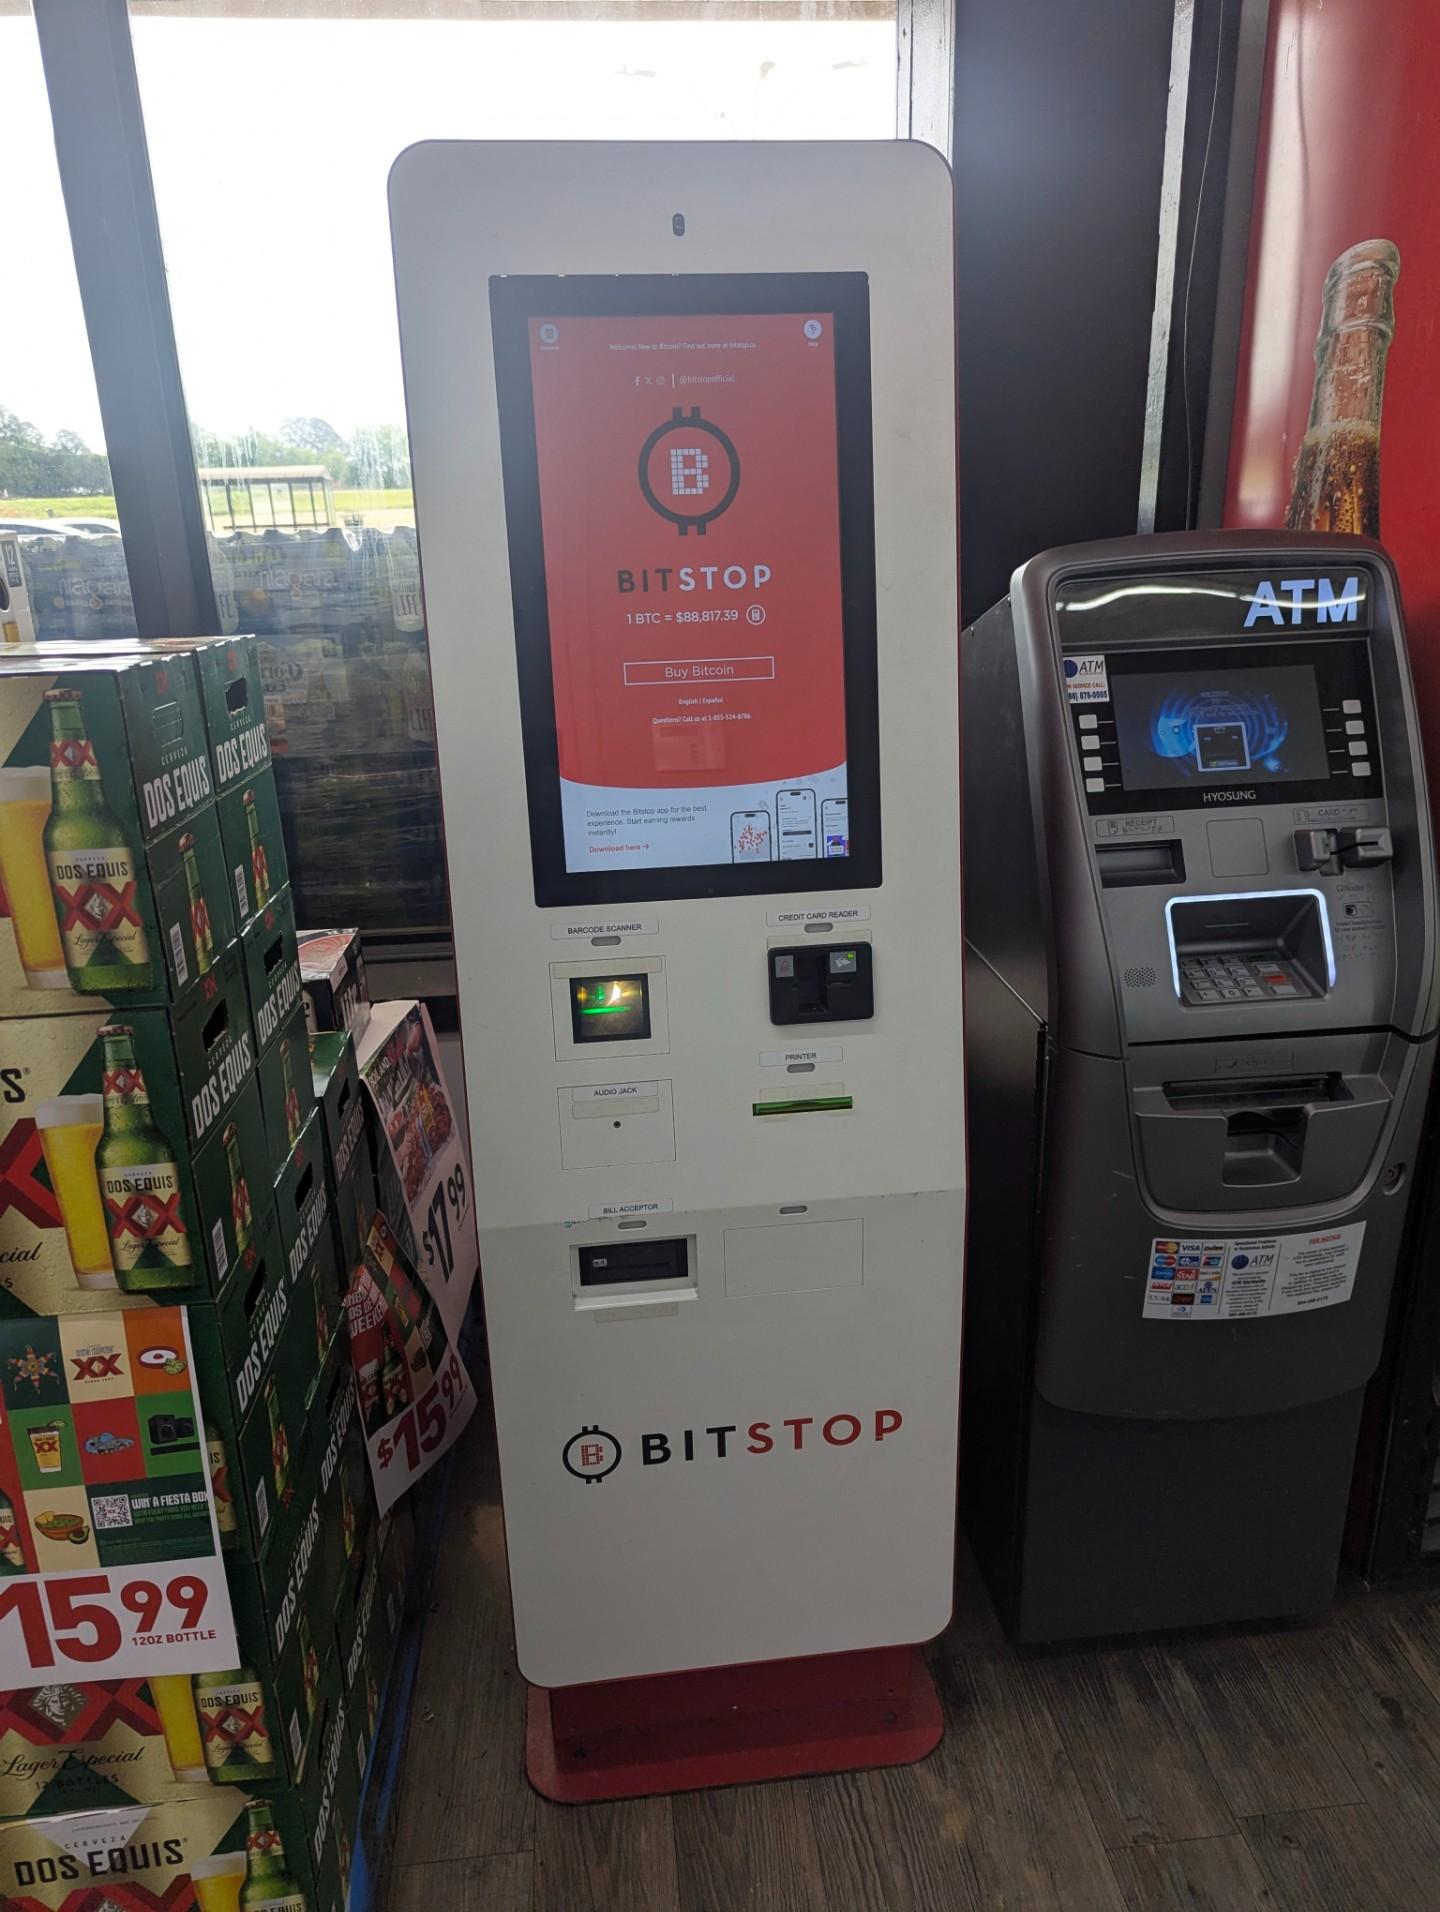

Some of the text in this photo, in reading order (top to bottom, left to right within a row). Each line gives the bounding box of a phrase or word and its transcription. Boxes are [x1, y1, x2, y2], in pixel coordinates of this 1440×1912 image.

[617, 564, 772, 593] BITSTOP
[1243, 577, 1359, 627] ATM
[626, 614, 632, 625] 1
[635, 612, 661, 624] BTC
[676, 609, 739, 624] $88,817.39
[665, 664, 734, 679] Buy Bitcoin
[1079, 660, 1104, 673] ATM
[678, 697, 699, 706] English
[216, 723, 268, 784] DOS EQUIS
[143, 755, 210, 829] DOS EQUIS
[1203, 790, 1257, 803] HYOSUNG
[586, 810, 619, 818] Download
[657, 808, 669, 816] app
[644, 817, 668, 825] earning
[588, 828, 617, 837] instantly!
[589, 844, 624, 853] Download
[56, 861, 129, 881] DOS EQUIS
[778, 910, 858, 922] CREDIT CARD READER
[567, 923, 642, 935] BARCODE SCANNER
[257, 962, 301, 1046] DOS EQUIS
[785, 1053, 817, 1061] PRINTER
[191, 1032, 252, 1139] DOS EQUIS
[594, 1086, 638, 1096] AUDIO JACK
[106, 1175, 174, 1194] DOS EQUIS
[603, 1203, 658, 1215] BILL ACCEPTOR
[289, 1180, 327, 1285] DOS EQUIS
[1250, 1254, 1275, 1265] ATM
[236, 1276, 287, 1415] DOS EQUIS
[70, 1352, 124, 1381] XX
[641, 1409, 903, 1465] BITSTOP
[320, 1432, 338, 1494] DOS
[131, 1498, 151, 1510] WIN
[153, 1497, 160, 1507] A
[160, 1493, 190, 1506] FIESTA
[191, 1491, 208, 1503] BOX
[275, 1495, 319, 1654] DOS EQUIS
[132, 1630, 217, 1646] 12OZ BOTTLE
[201, 1691, 259, 1708] DOS EQUIS
[2, 1746, 145, 1781] Lager Especial
[314, 1697, 345, 1865] DOS EQUIS
[64, 1834, 127, 1849] CERVEZA
[15, 1840, 184, 1887] DOS EQUIS
